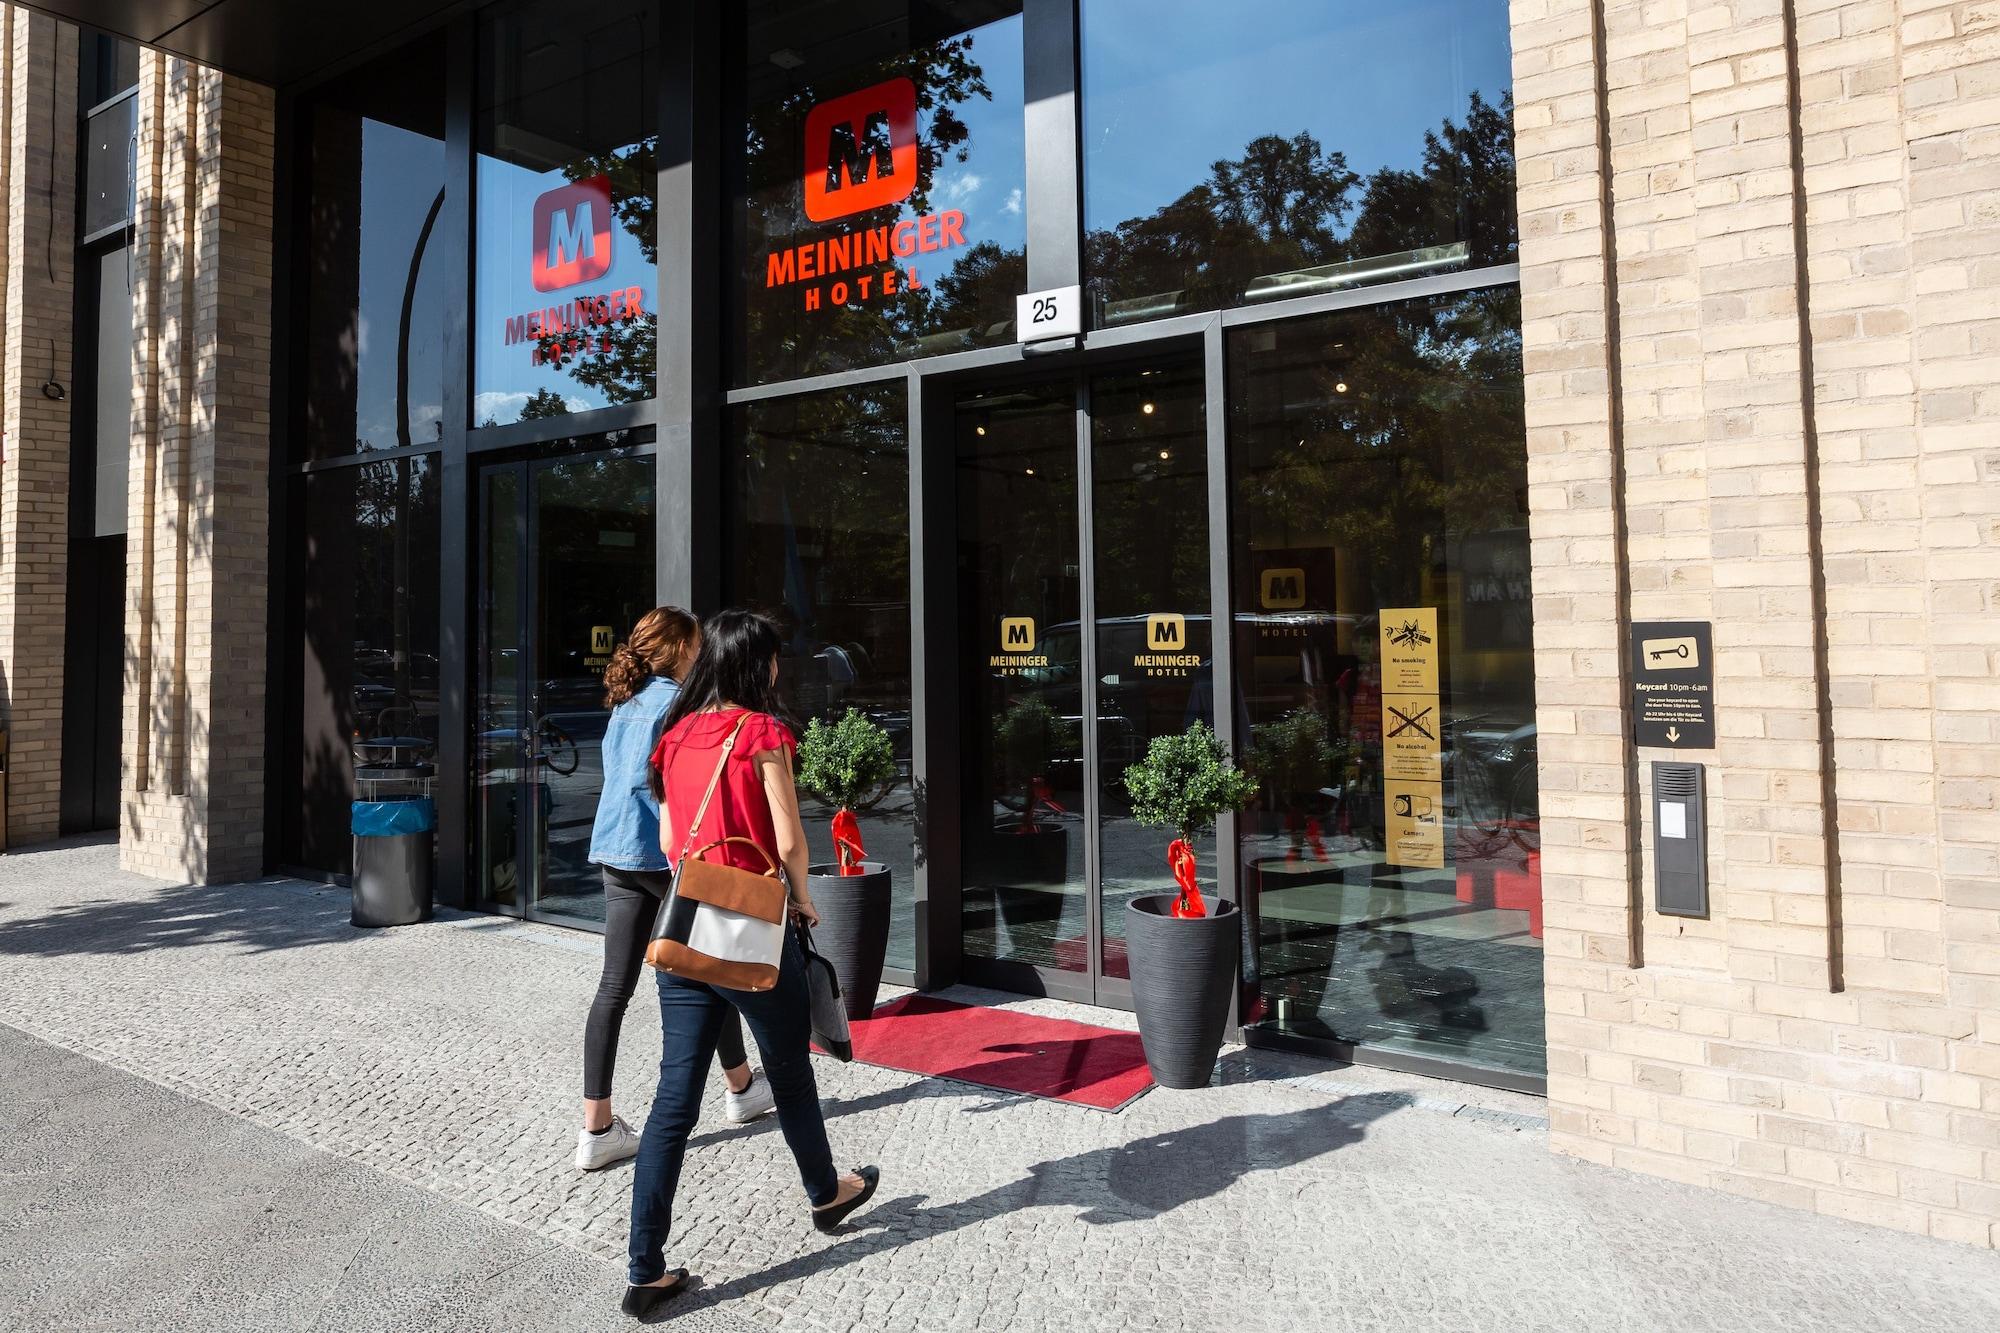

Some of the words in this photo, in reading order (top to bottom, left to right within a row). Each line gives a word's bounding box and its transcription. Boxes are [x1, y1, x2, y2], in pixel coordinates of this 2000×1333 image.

[825, 109, 895, 194] M
[546, 200, 596, 271] M
[766, 208, 966, 288] MEININGER
[805, 266, 922, 312] HOTEL
[504, 285, 643, 346] MEININGER
[1032, 297, 1058, 323] 25
[531, 332, 613, 367] HOTEL
[1269, 576, 1298, 599] M
[596, 632, 609, 648] M
[1008, 625, 1028, 644] M
[1154, 622, 1178, 642] M
[990, 655, 1048, 667] MEININGER
[1134, 655, 1201, 667] MEININGER
[1147, 668, 1187, 676] HOTEL
[1635, 683, 1668, 692] Keycard
